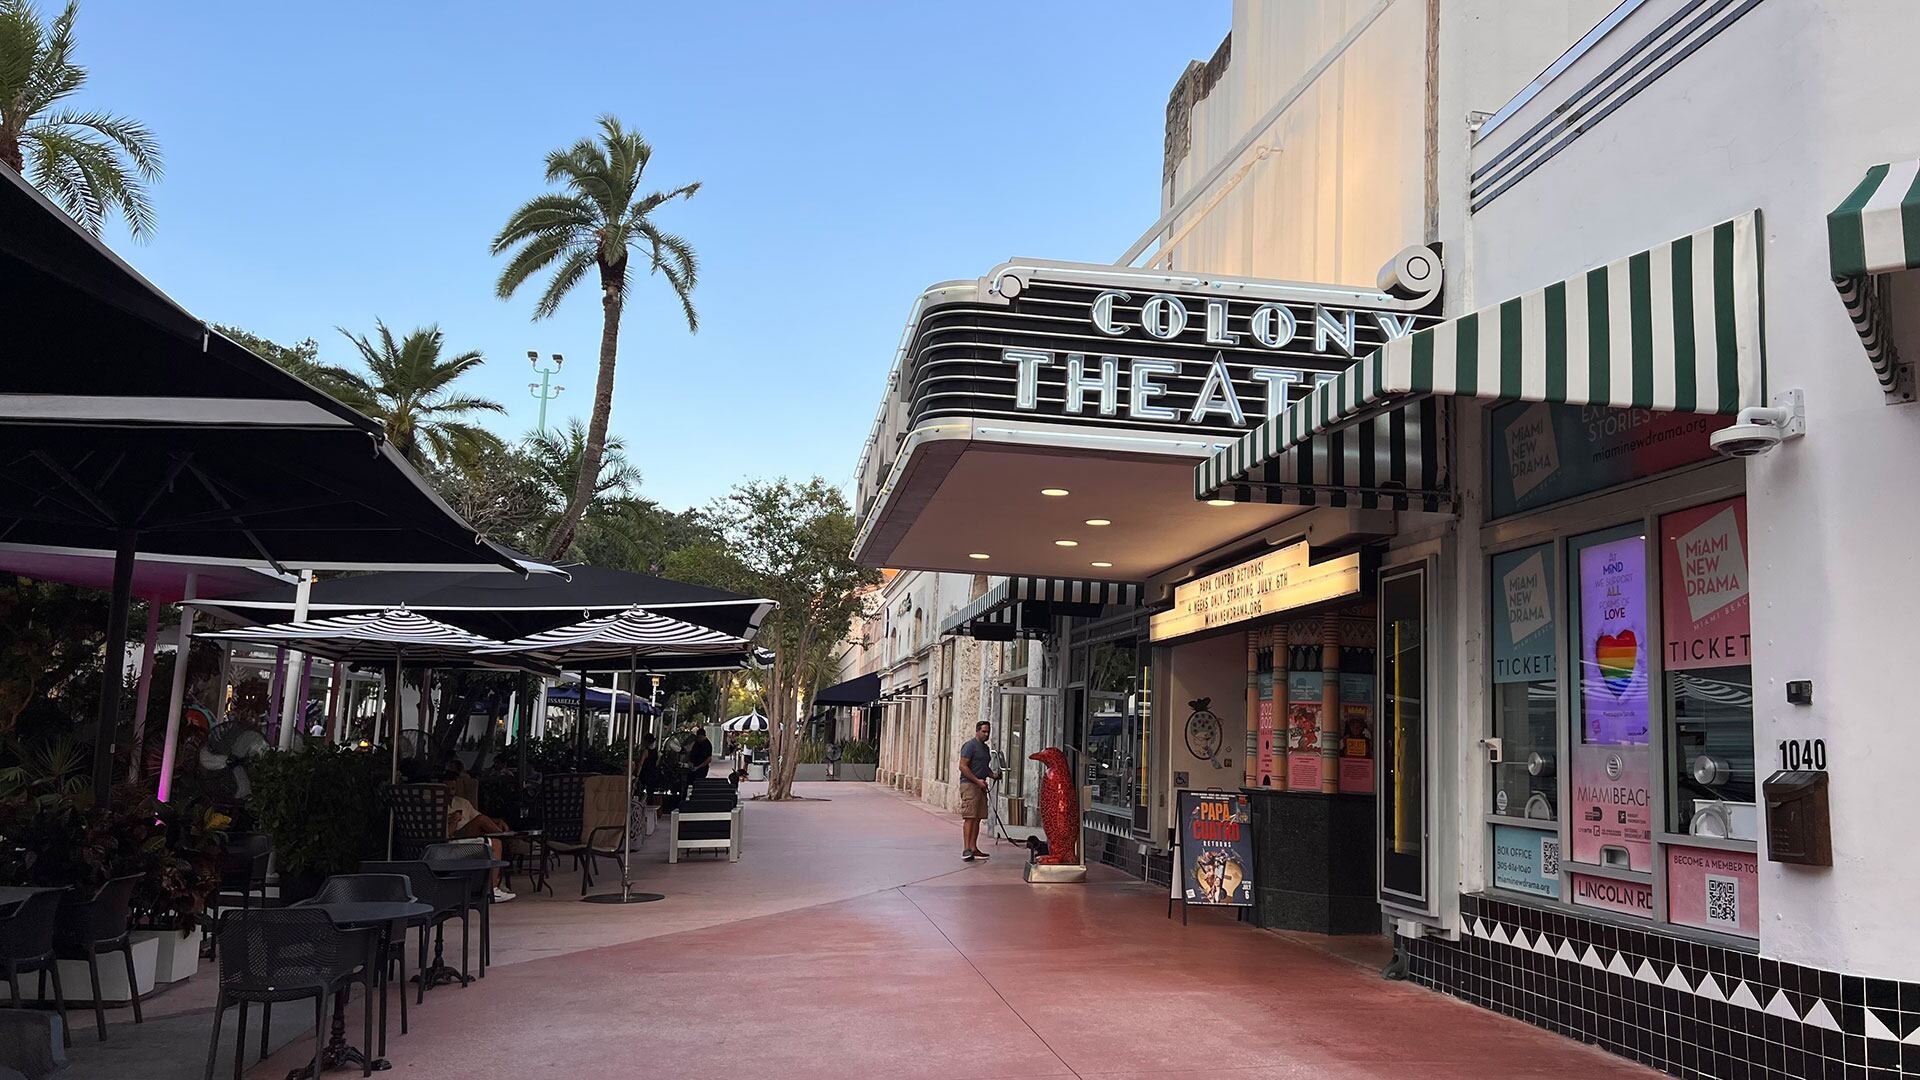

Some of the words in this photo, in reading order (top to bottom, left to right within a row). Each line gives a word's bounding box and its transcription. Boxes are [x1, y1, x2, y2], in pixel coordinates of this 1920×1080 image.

[1089, 289, 1417, 358] COLONY
[1002, 348, 1341, 427] THEAT
[1588, 409, 1650, 442] STORIES
[1511, 440, 1537, 461] NEW
[1592, 418, 1708, 464] miaminewdrama.org
[1511, 455, 1551, 479] DRAMA
[1199, 580, 1212, 594] PAPA
[1214, 571, 1235, 590] CUATRO
[1237, 561, 1264, 580] RETURNS!
[1686, 556, 1720, 578] NEW
[1194, 597, 1209, 612] WEEKS
[1226, 583, 1254, 603] STARTING
[1257, 577, 1273, 595] JULY
[1276, 572, 1288, 589] 6TH
[1607, 585, 1622, 597] ALL
[1687, 574, 1740, 597] DRAMA
[1509, 591, 1532, 607] NEW
[1725, 597, 1748, 615] BEAC
[1510, 607, 1545, 623] DRAMA
[1604, 607, 1626, 620] LOVE
[1260, 702, 1273, 716] 202
[1779, 739, 1827, 771] 1040
[1193, 820, 1241, 842] CUATRO
[1497, 845, 1509, 856] BOX
[1510, 847, 1532, 860] OFFICE
[1673, 855, 1703, 868] BECOME
[1705, 859, 1711, 868] A
[1711, 860, 1743, 872] MEMBER
[1497, 875, 1551, 895] miaminewdrama.org
[1578, 880, 1634, 907] LINCOLN
